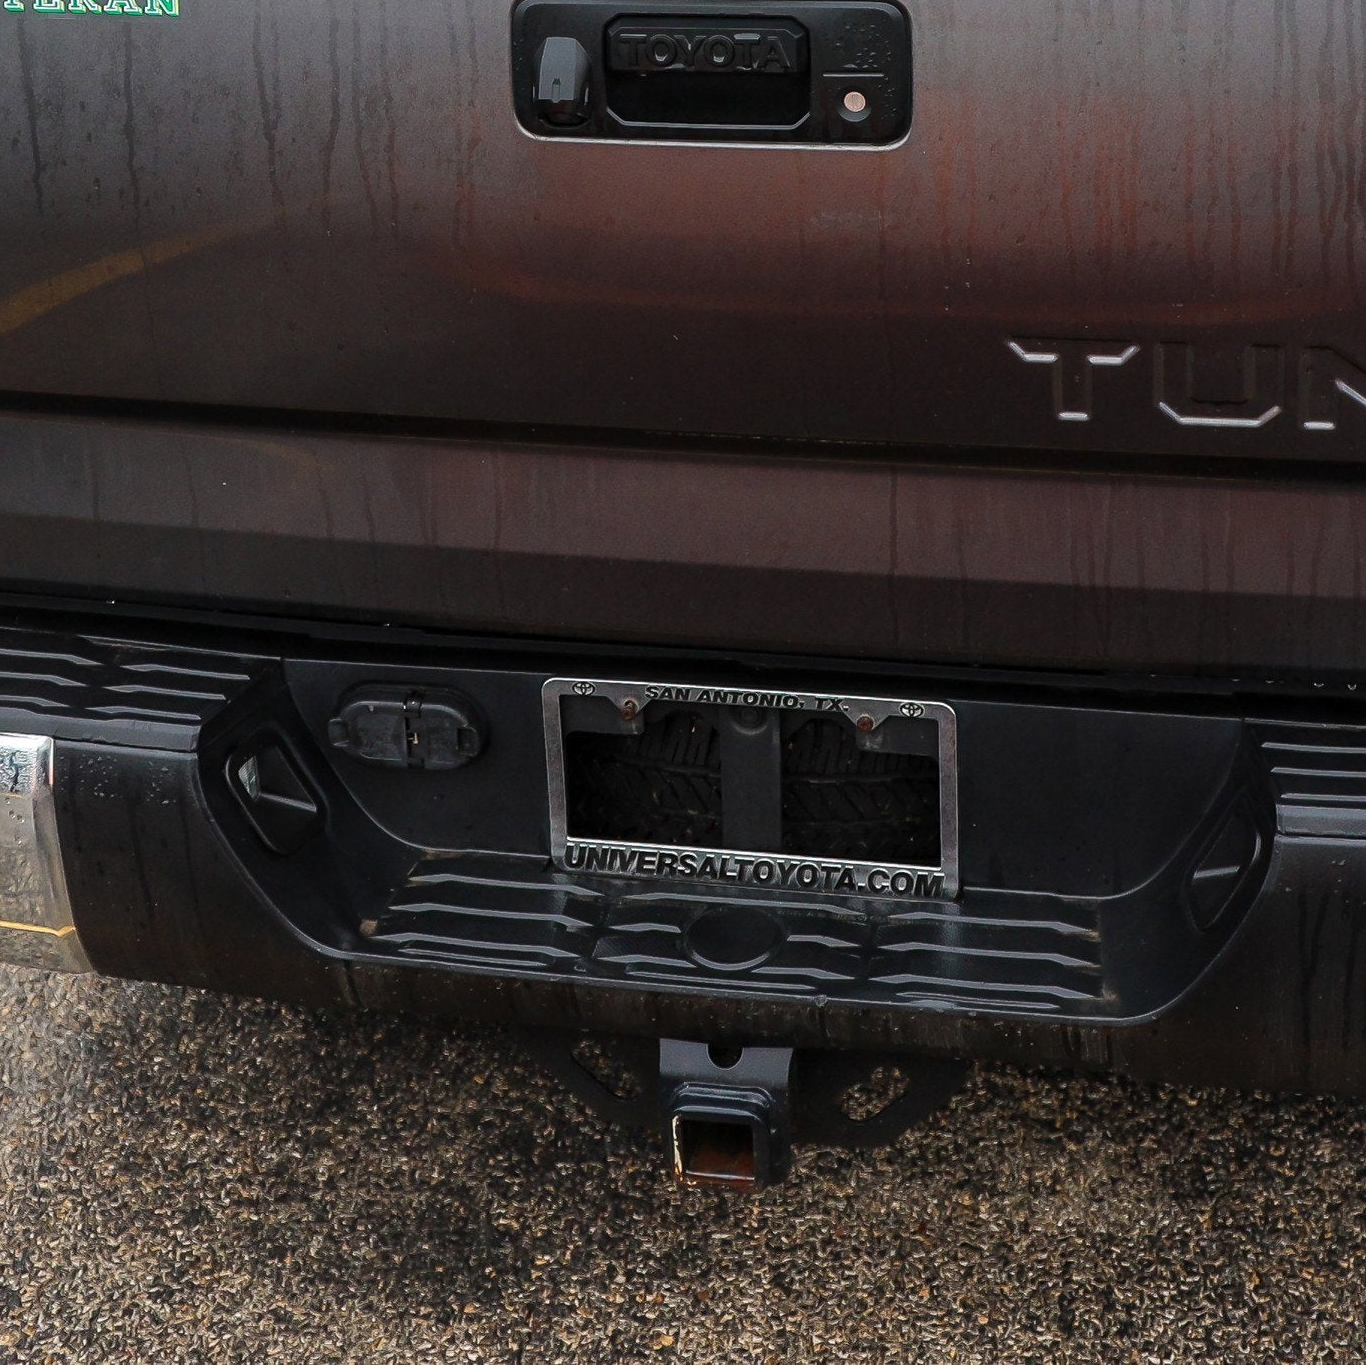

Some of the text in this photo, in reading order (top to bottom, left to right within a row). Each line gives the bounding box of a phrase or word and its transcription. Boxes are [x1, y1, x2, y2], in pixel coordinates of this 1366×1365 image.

[619, 33, 793, 71] TOYOTA
[644, 685, 690, 702] SAN
[564, 842, 945, 897] UNIVERSALTOYOTA.COM
